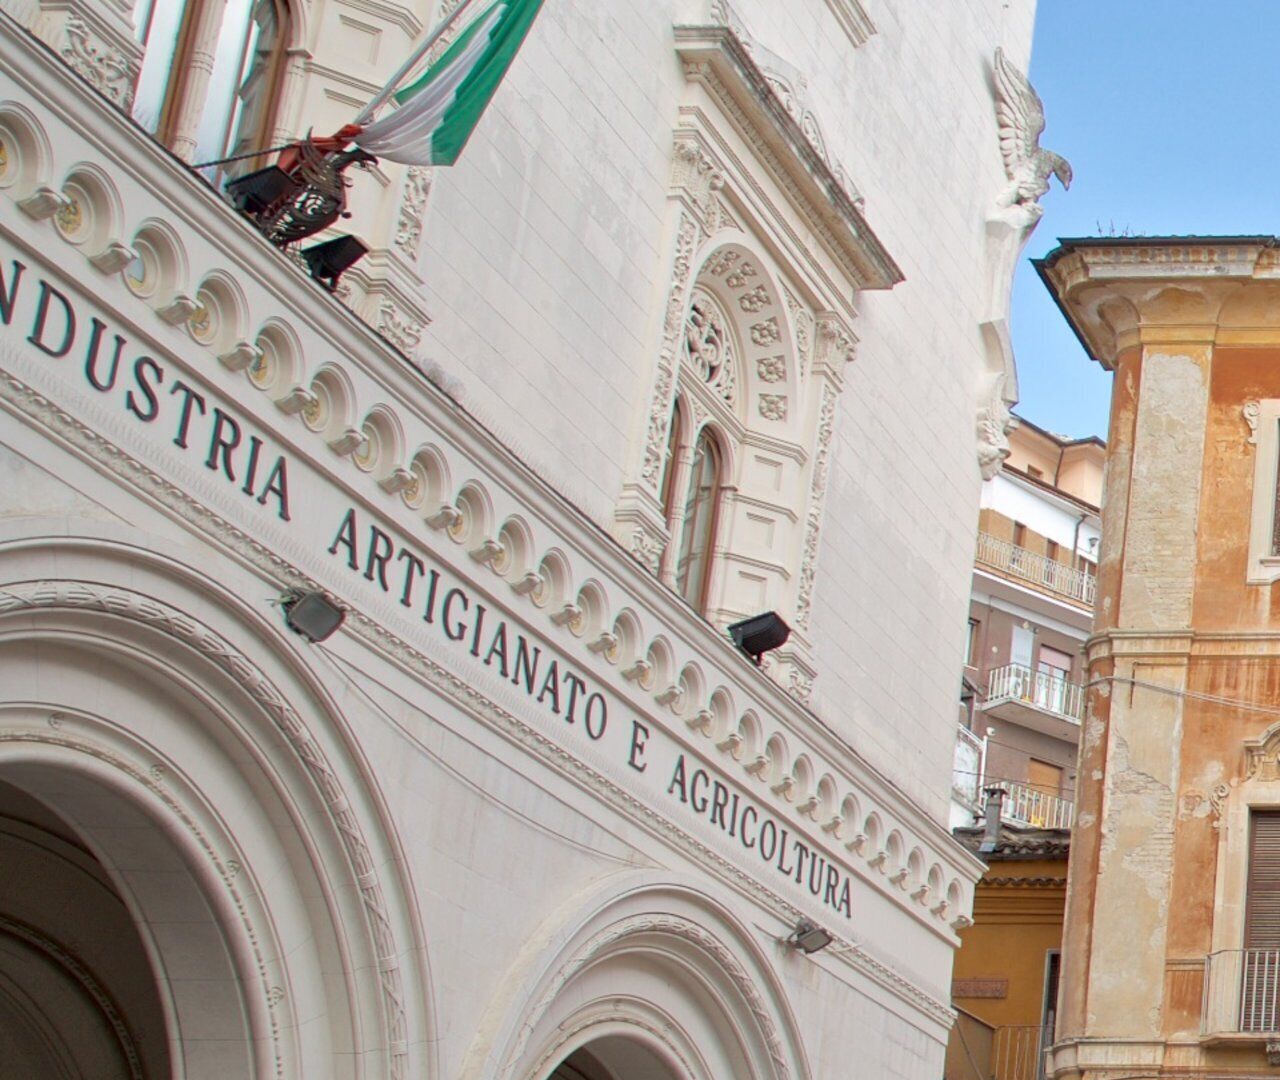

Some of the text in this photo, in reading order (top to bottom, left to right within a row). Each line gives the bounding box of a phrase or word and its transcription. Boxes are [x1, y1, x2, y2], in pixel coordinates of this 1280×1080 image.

[328, 508, 607, 740] ARTIGIANATO
[627, 720, 650, 772] E
[668, 754, 852, 919] AGRICOLTURA
